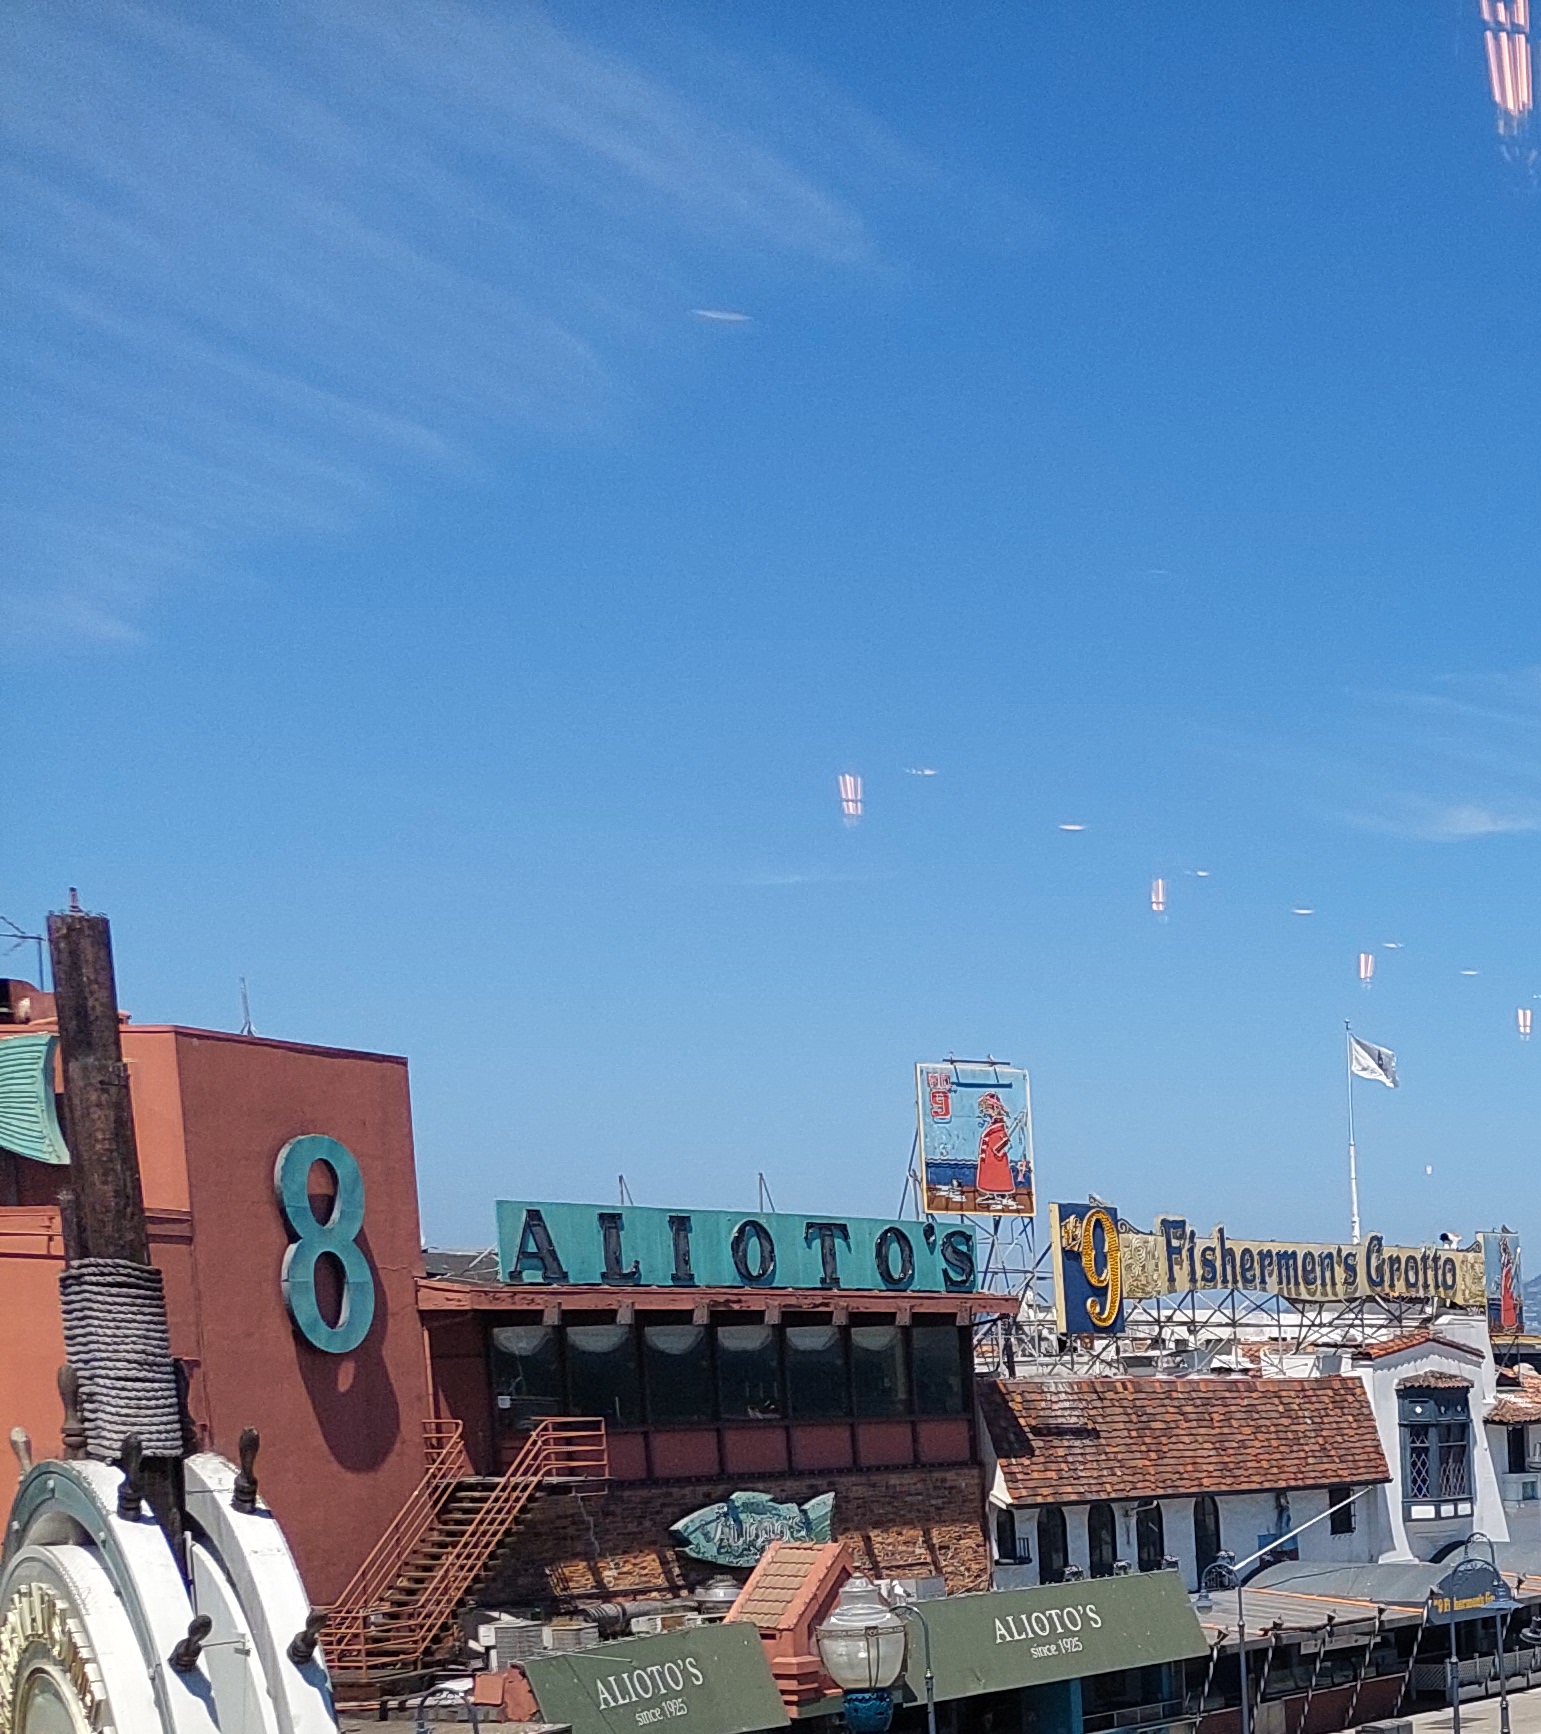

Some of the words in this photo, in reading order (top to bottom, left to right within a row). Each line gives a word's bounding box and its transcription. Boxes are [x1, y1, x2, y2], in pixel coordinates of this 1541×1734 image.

[929, 1089, 951, 1119] 9
[274, 1134, 375, 1354] 8
[508, 1208, 975, 1293] ALIOTO'S
[1079, 1207, 1121, 1327] 9
[1160, 1217, 1358, 1288] Fishermen's
[1366, 1233, 1457, 1291] Grotto
[994, 1604, 1102, 1644] ALIOTO'S
[1030, 1644, 1058, 1659] since
[1058, 1637, 1083, 1654] 1925
[595, 1656, 704, 1710] ALIOTO'S
[635, 1705, 664, 1727] since
[664, 1698, 688, 1721] 1925
